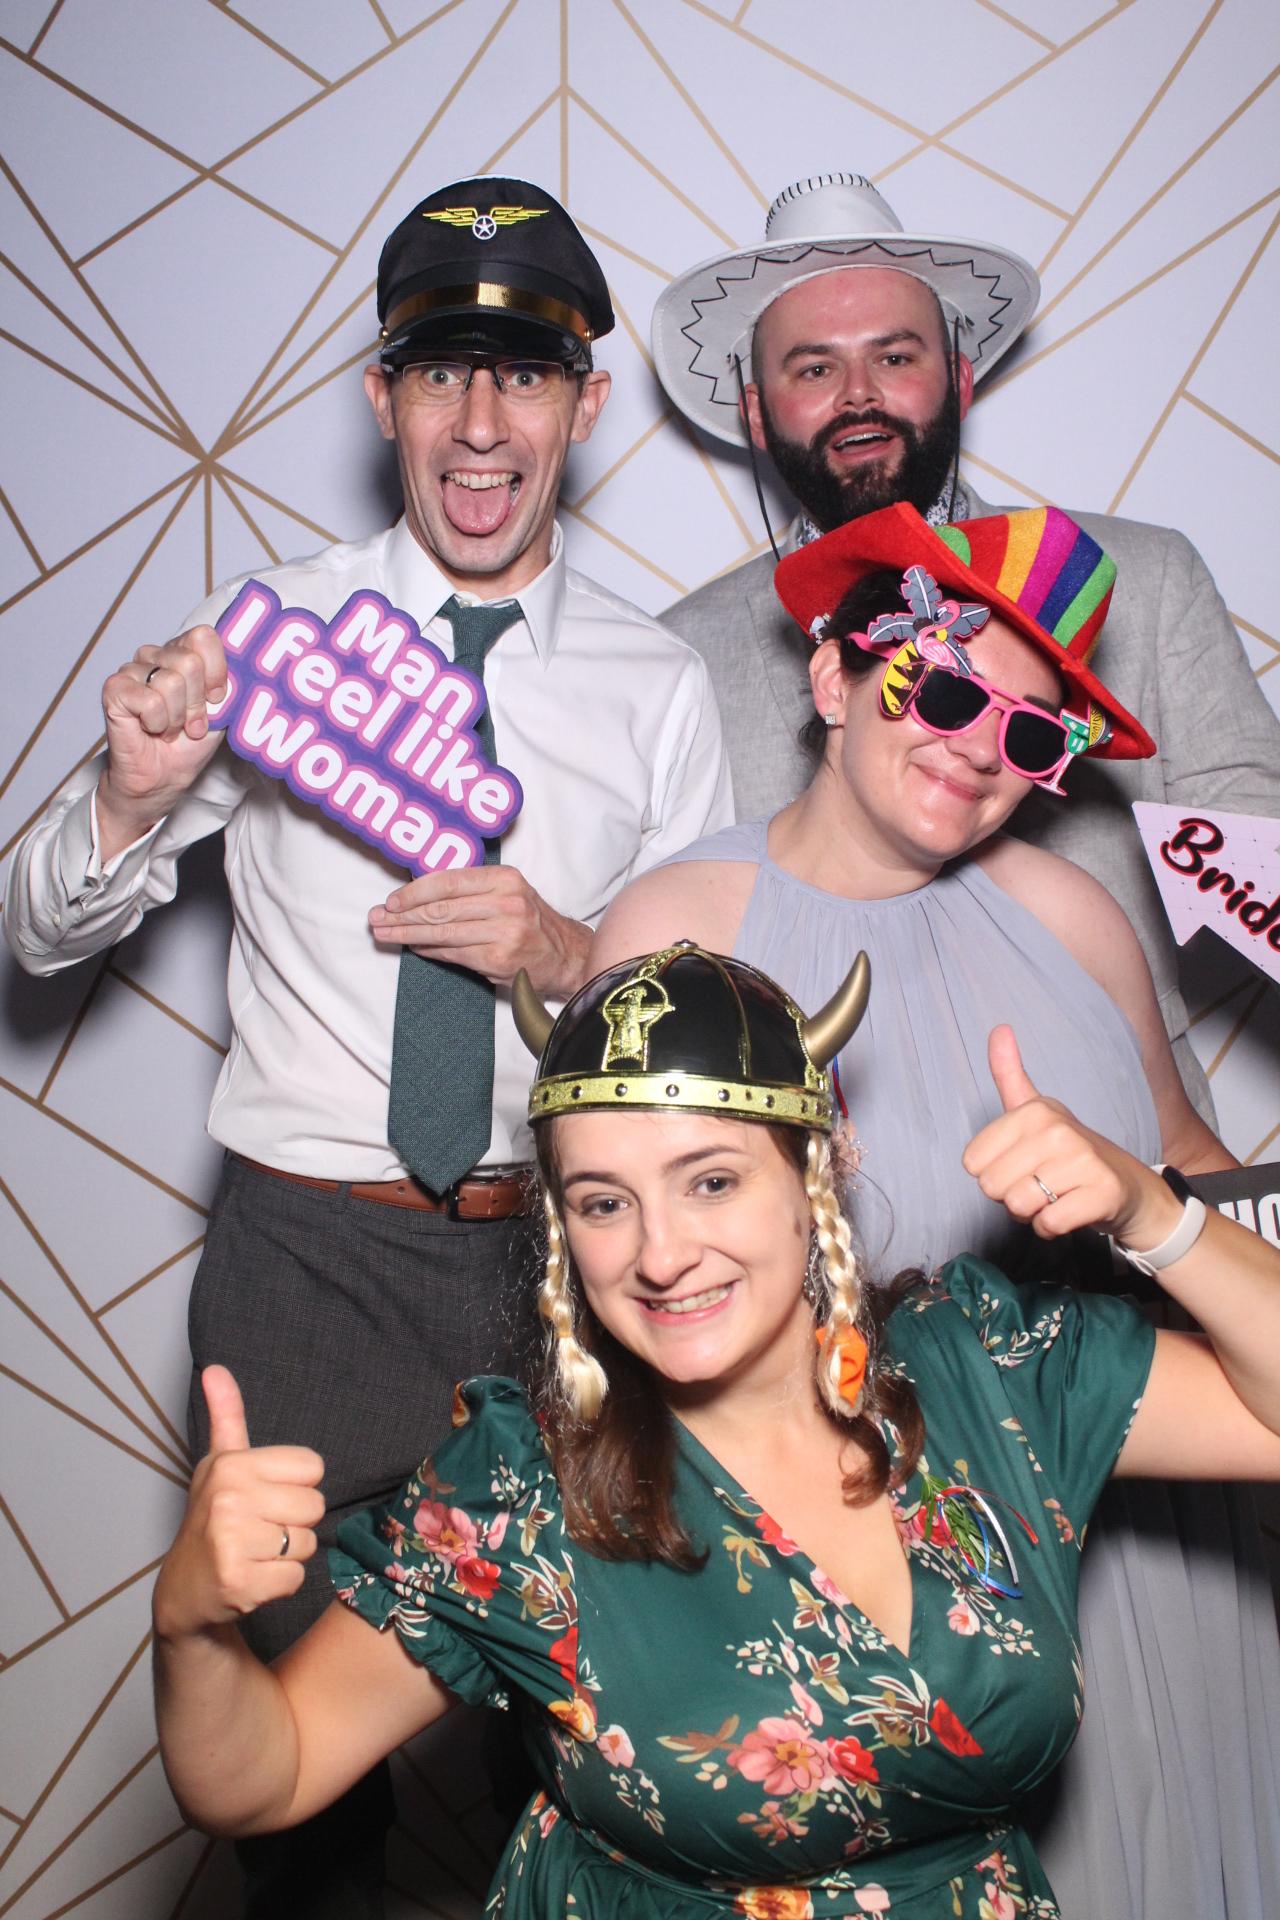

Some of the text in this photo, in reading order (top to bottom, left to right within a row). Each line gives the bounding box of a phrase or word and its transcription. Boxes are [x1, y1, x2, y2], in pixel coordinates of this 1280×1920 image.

[227, 597, 511, 824] I feel like
[336, 603, 473, 728] Man
[241, 690, 472, 870] Woman
